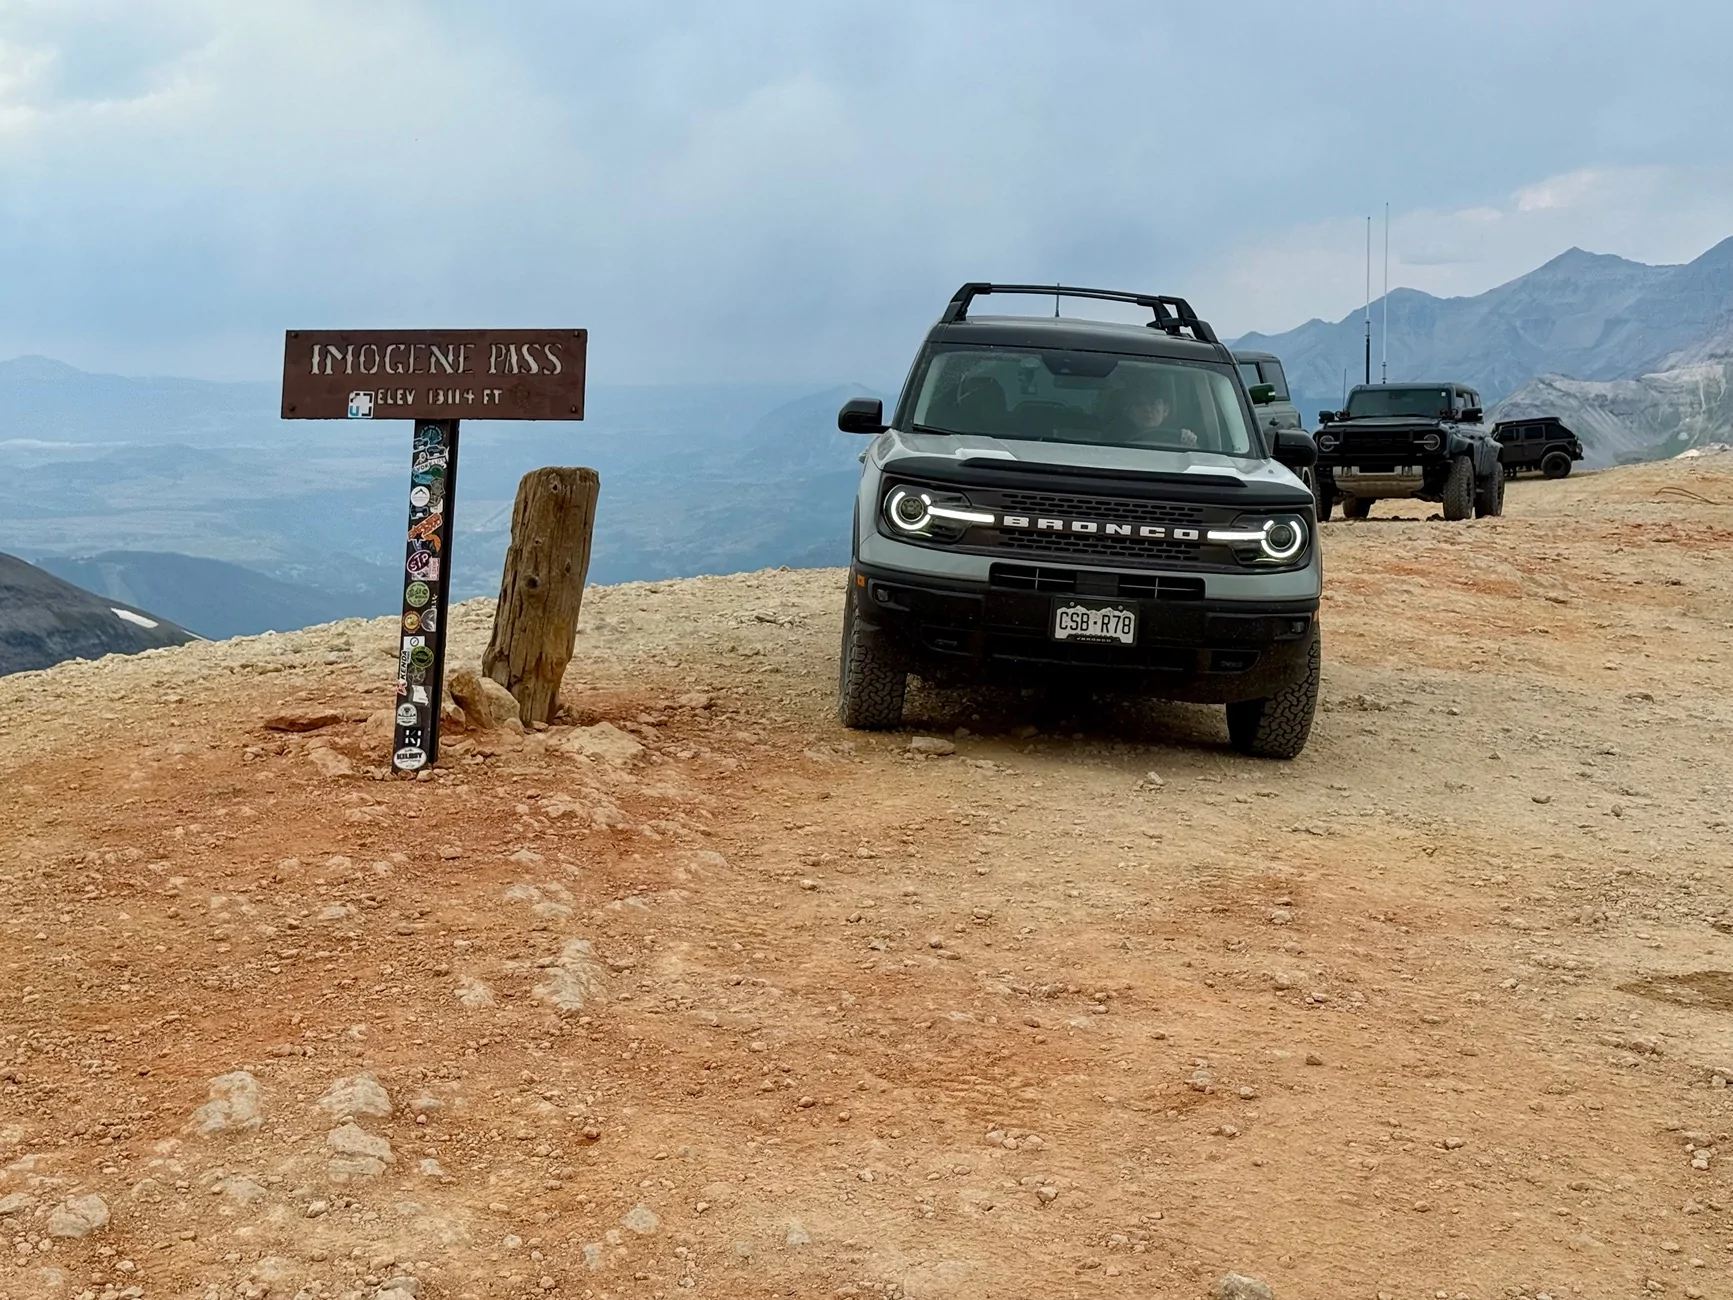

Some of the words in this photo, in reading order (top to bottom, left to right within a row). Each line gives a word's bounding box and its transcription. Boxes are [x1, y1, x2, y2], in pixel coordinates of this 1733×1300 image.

[309, 343, 476, 376] IMOGENE
[487, 343, 563, 376] PASS
[376, 388, 416, 405] ELEV
[427, 388, 475, 405] 13114
[482, 388, 503, 405] FT
[1003, 514, 1200, 541] BRONCO
[410, 553, 429, 571] STP
